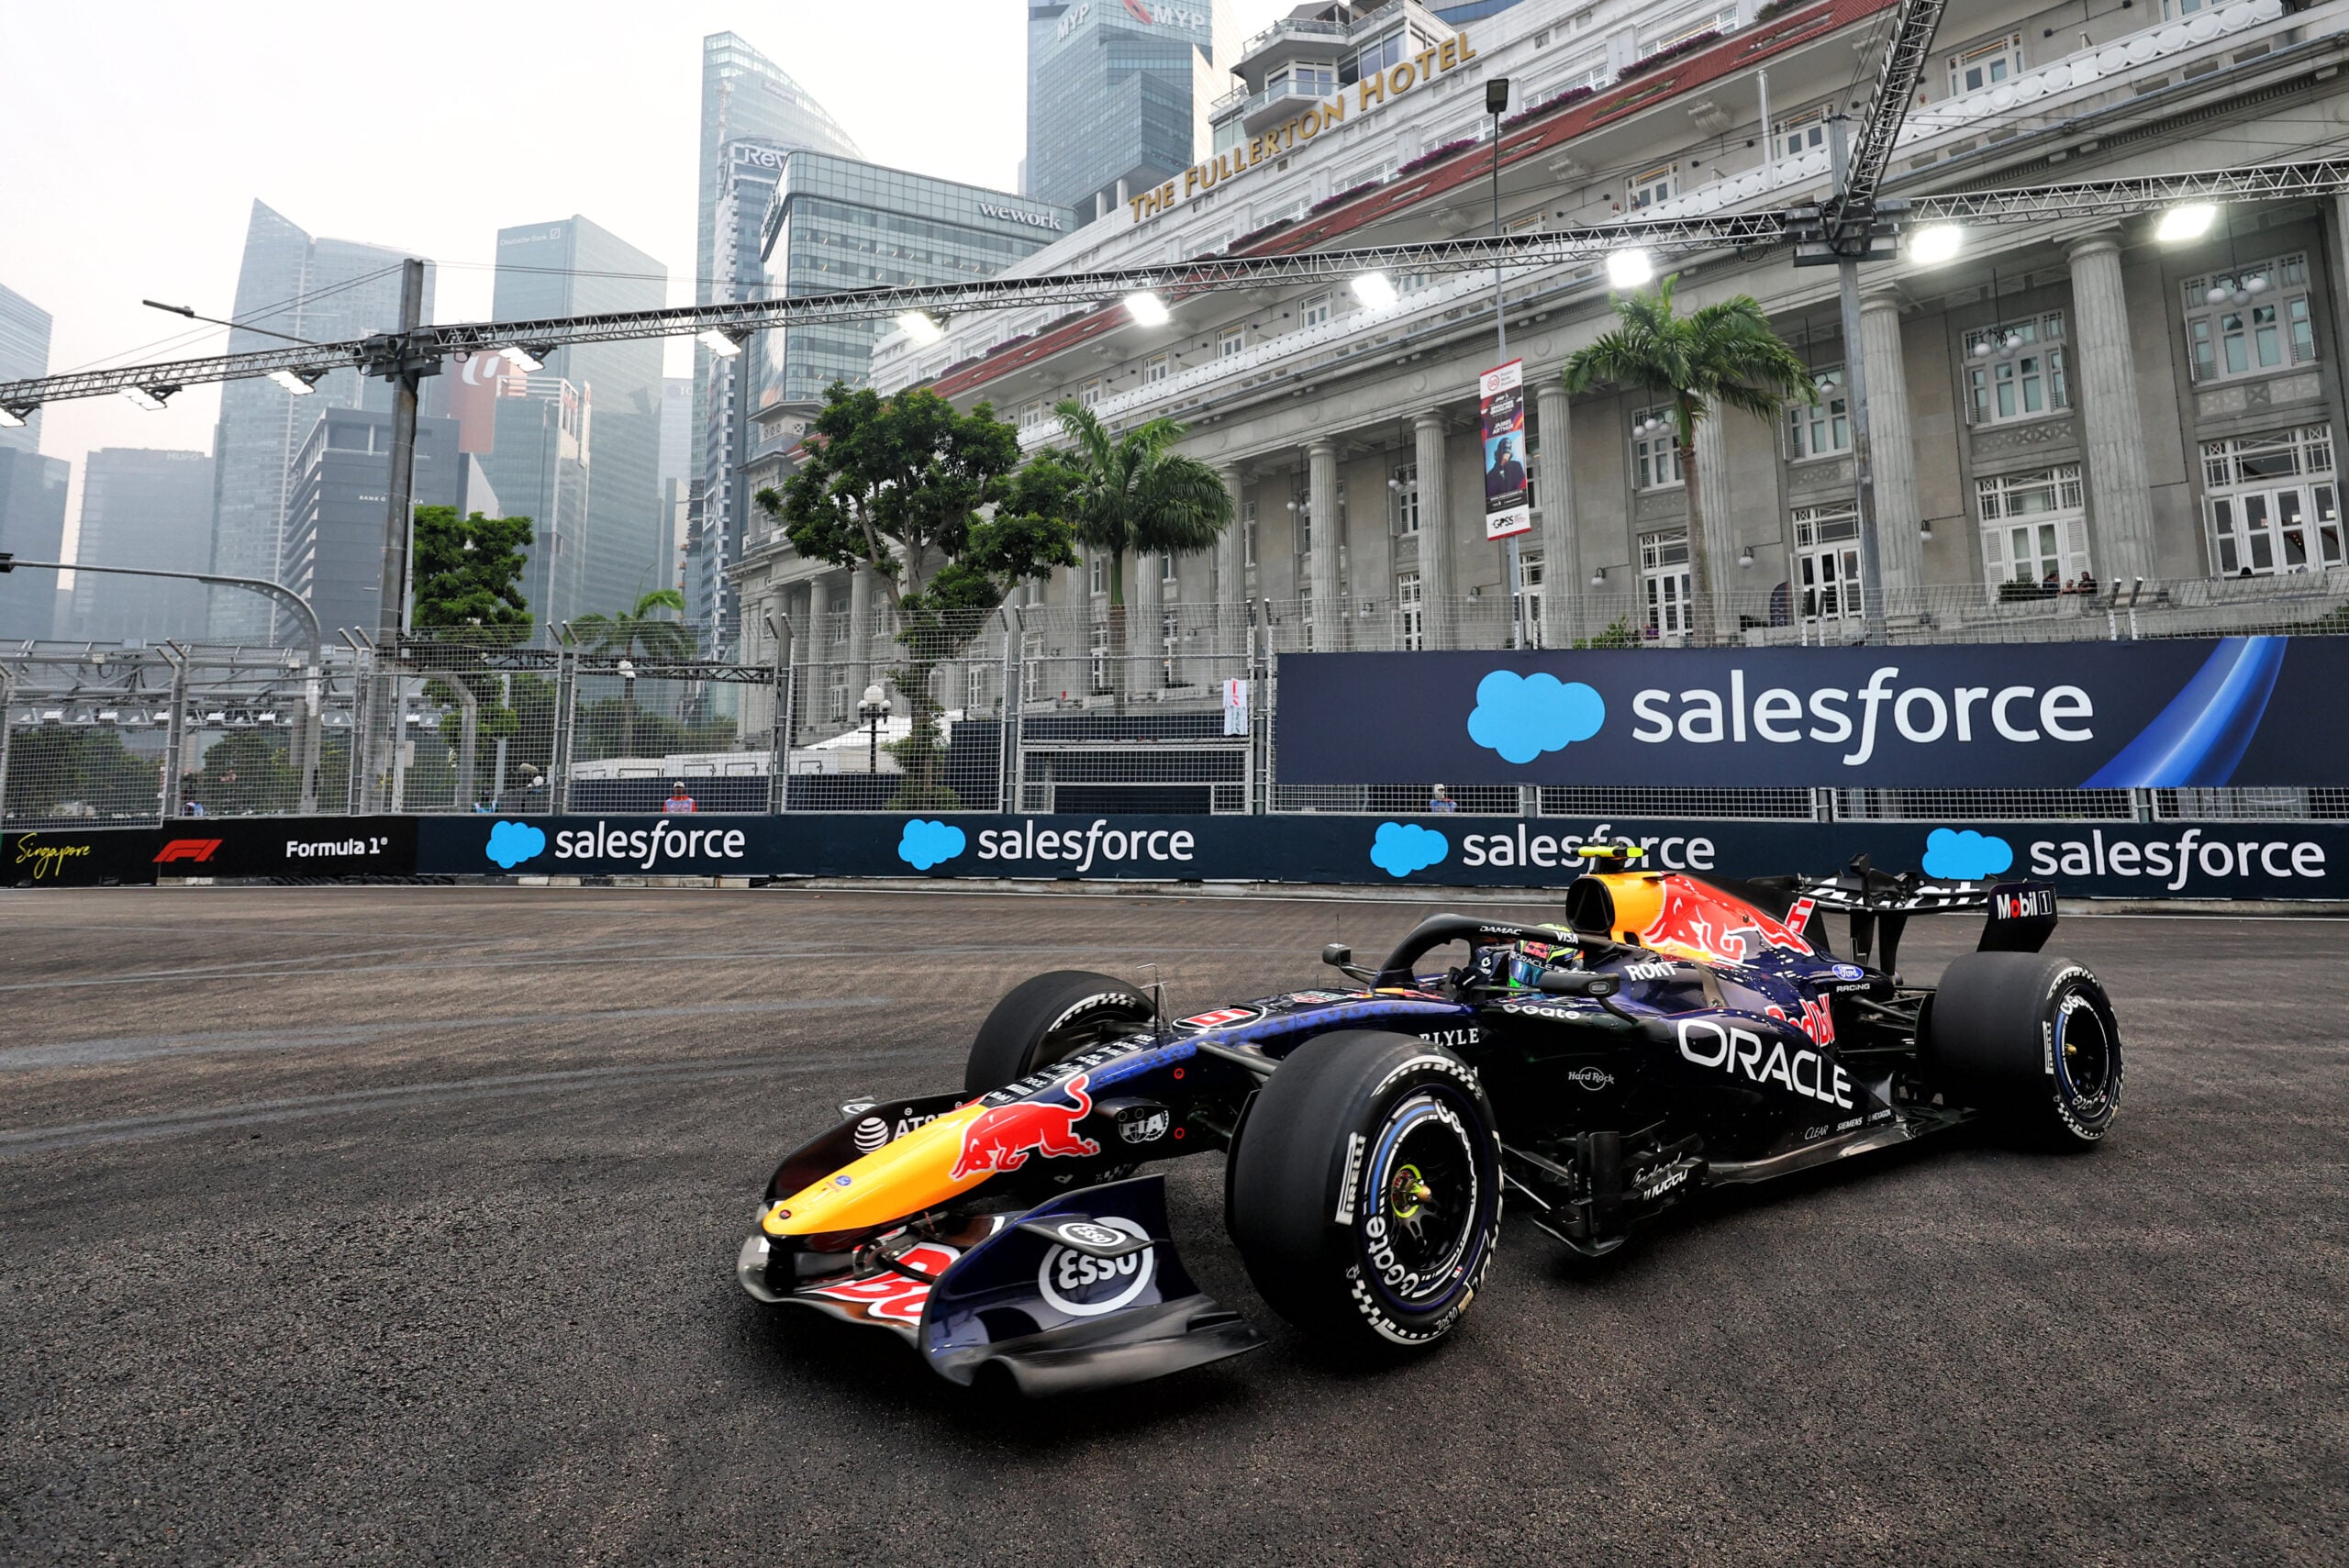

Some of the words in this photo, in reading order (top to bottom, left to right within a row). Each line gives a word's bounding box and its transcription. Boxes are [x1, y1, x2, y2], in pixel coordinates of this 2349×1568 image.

[1057, 3, 1090, 41] MYP
[1153, 5, 1206, 30] MYP
[1130, 181, 1175, 223] THE
[1185, 94, 1344, 197] FULLERTON
[1360, 32, 1476, 111] HOTEL
[979, 202, 1063, 230] wework
[1492, 423, 1514, 435] ARTHUR
[1494, 418, 1512, 428] JAMES
[1632, 667, 2094, 767] salesforce
[16, 833, 91, 879] Singapore
[286, 839, 365, 858] Formula
[555, 820, 745, 869] salesforce
[978, 819, 1194, 872] salesforce
[2030, 829, 2326, 890] salesforce
[1997, 892, 2037, 920] Mobil
[2040, 892, 2051, 914] 1
[1479, 925, 1522, 936] DAMAC
[1553, 930, 1578, 944] VISA
[1515, 954, 1553, 971] ORACLE
[1568, 1071, 1591, 1081] Hard
[1592, 1072, 1615, 1084] Rock
[1677, 1018, 1854, 1109] ORACLE
[1805, 1125, 1829, 1140] CLEAR
[1836, 1117, 1864, 1131] SIEMENS
[1335, 1131, 1367, 1226] PIRELLI
